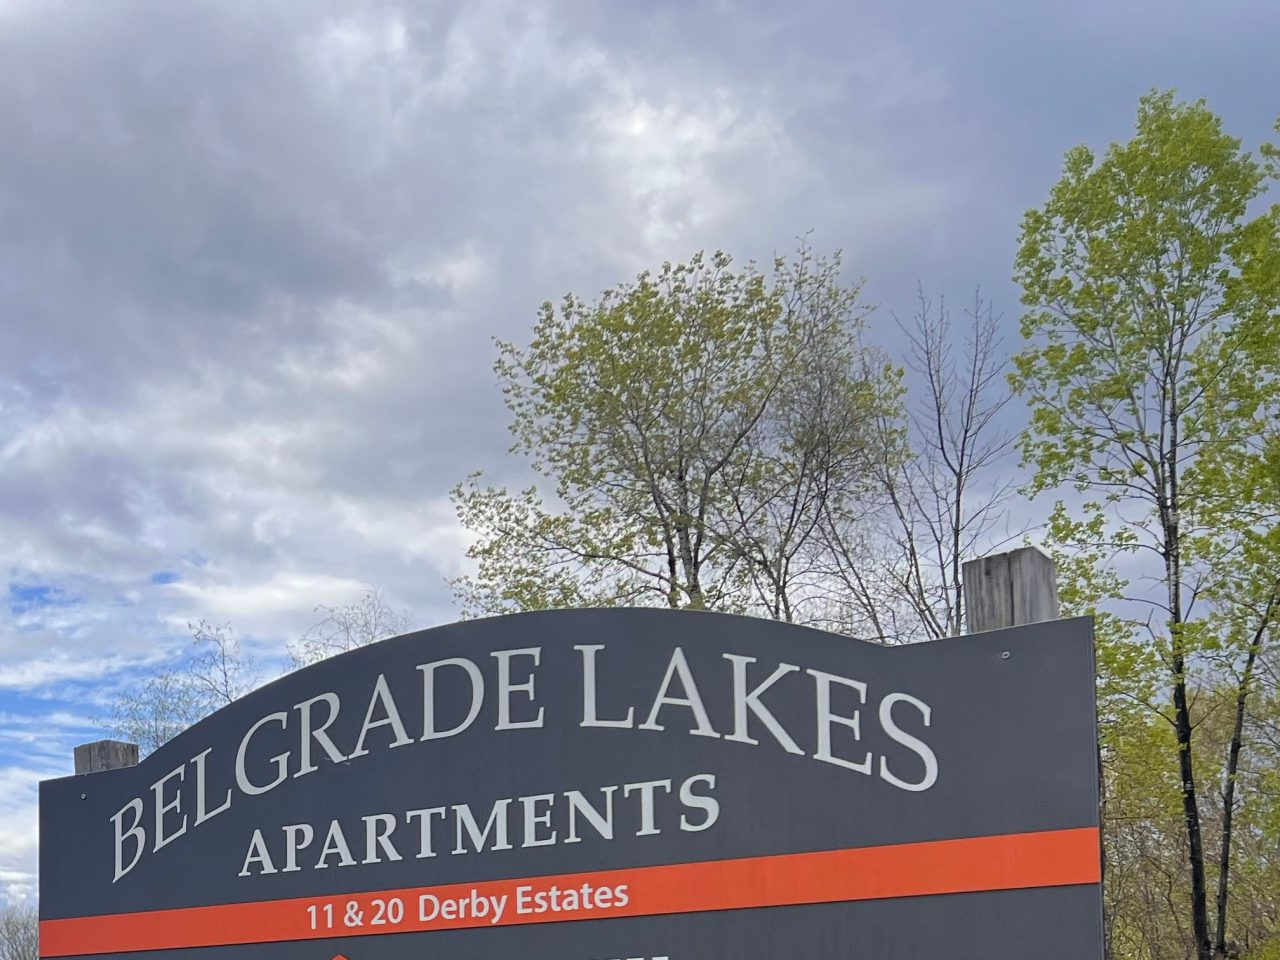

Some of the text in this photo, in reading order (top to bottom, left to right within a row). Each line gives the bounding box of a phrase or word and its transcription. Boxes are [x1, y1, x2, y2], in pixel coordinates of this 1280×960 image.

[110, 644, 939, 884] BELGRADE LAKES
[238, 774, 720, 877] APARTMENTS
[307, 883, 630, 930] 11 & 20 Derby Estates
